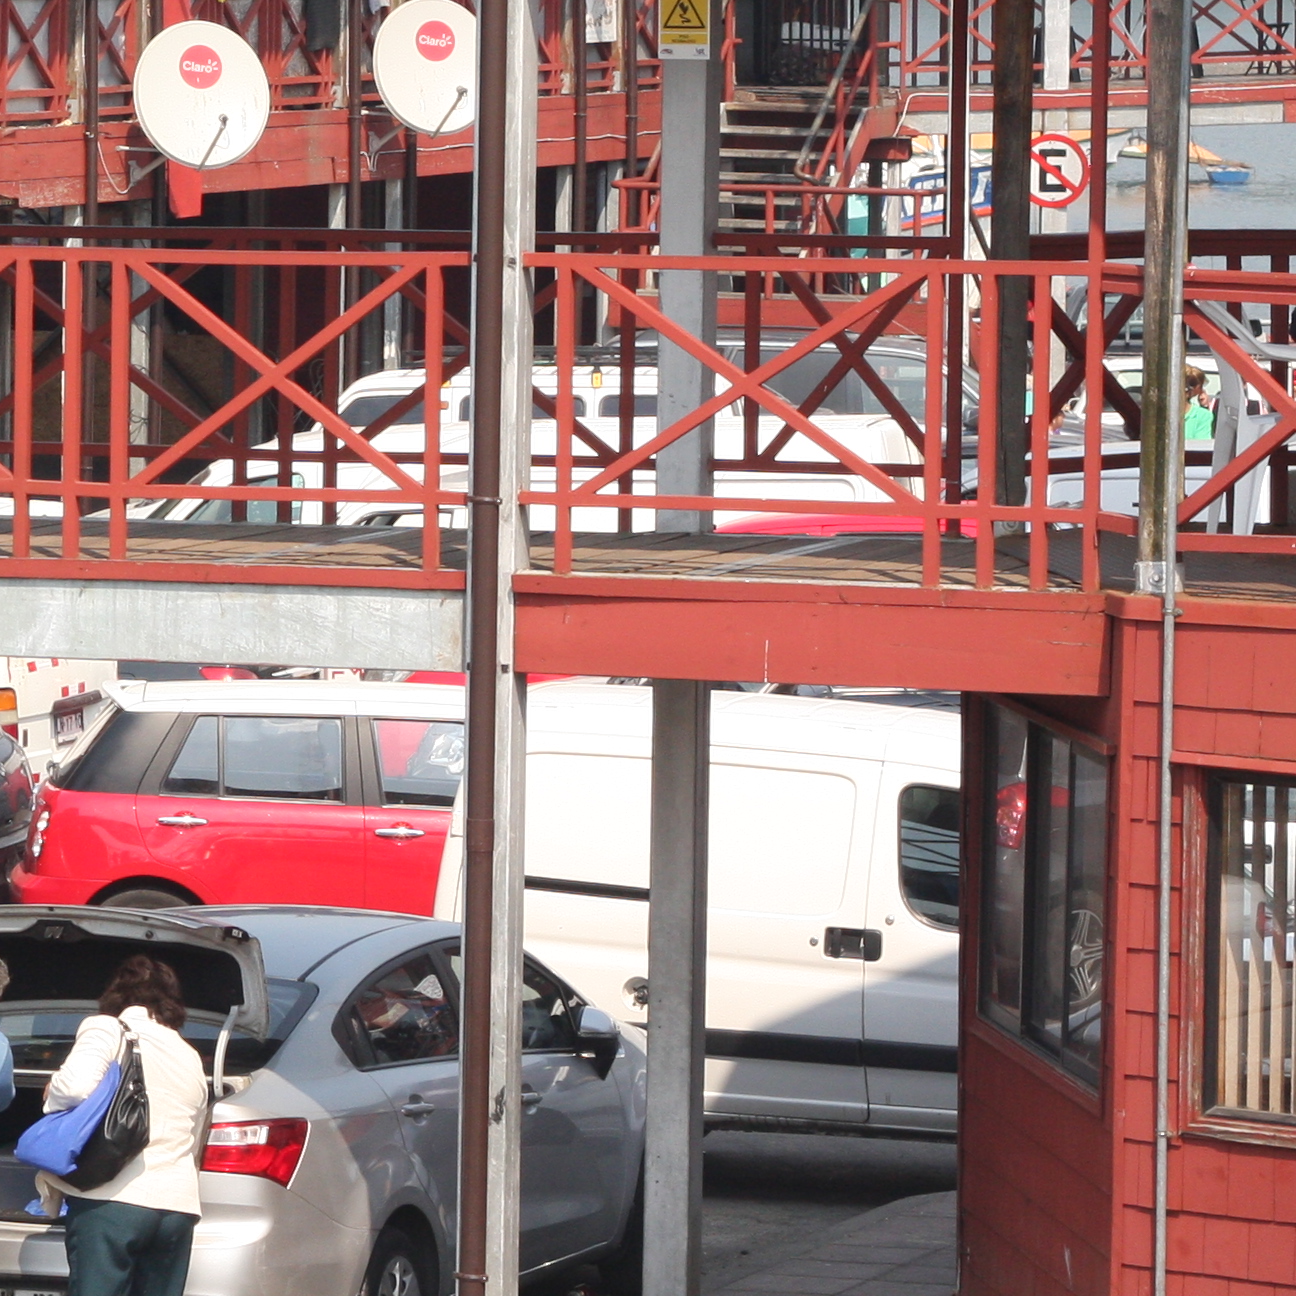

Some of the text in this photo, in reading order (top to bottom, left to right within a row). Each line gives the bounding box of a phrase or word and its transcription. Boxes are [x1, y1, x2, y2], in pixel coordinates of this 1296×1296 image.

[418, 34, 448, 48] Claro
[182, 59, 214, 74] Claro
[1038, 149, 1067, 193] E
